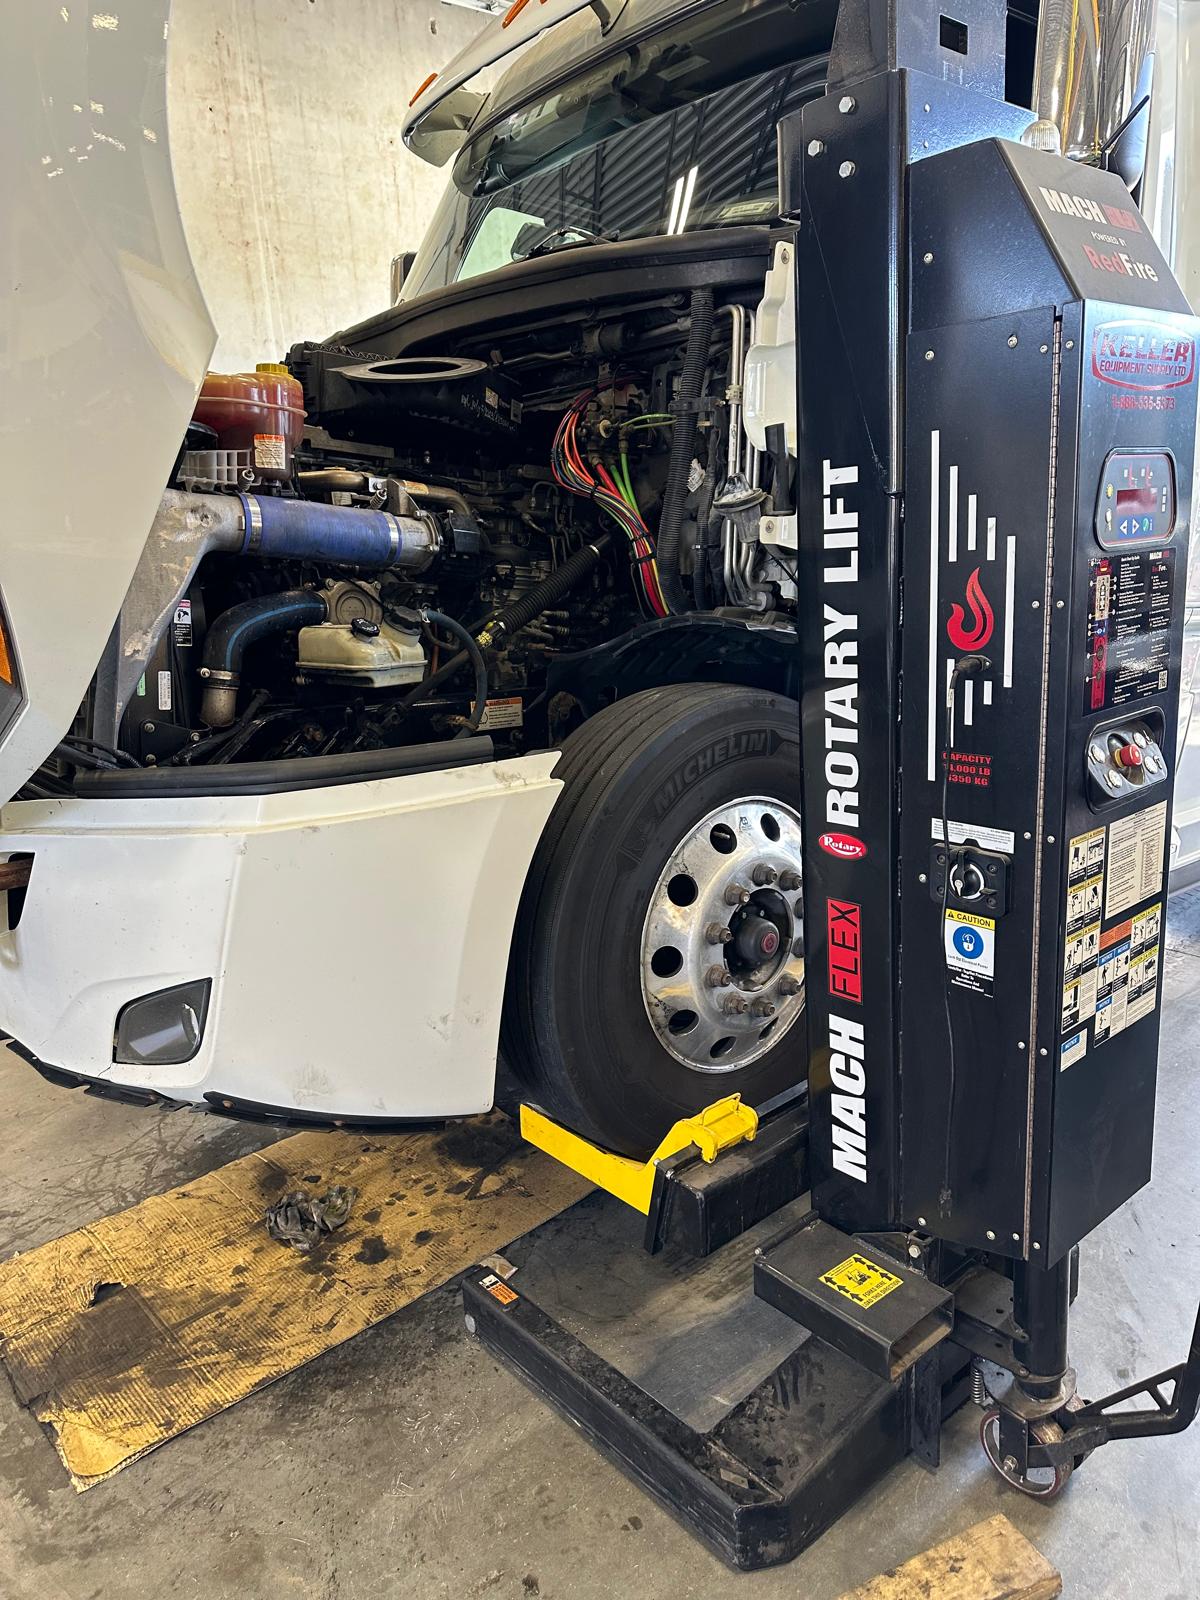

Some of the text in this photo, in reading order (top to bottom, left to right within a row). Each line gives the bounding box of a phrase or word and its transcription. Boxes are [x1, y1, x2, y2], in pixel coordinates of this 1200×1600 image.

[1039, 186, 1107, 225] MACH
[1083, 244, 1158, 281] RedFire
[1100, 360, 1145, 375] EQUIPMENT
[1174, 366, 1186, 377] LTD
[823, 460, 860, 828] ROTARY LIFT
[654, 731, 767, 816] MICHELIN
[974, 777, 988, 786] KG
[979, 767, 990, 776] LB
[824, 836, 862, 855] Rotary
[957, 914, 991, 927] CAUTION
[829, 902, 867, 1184] MACH FLEX
